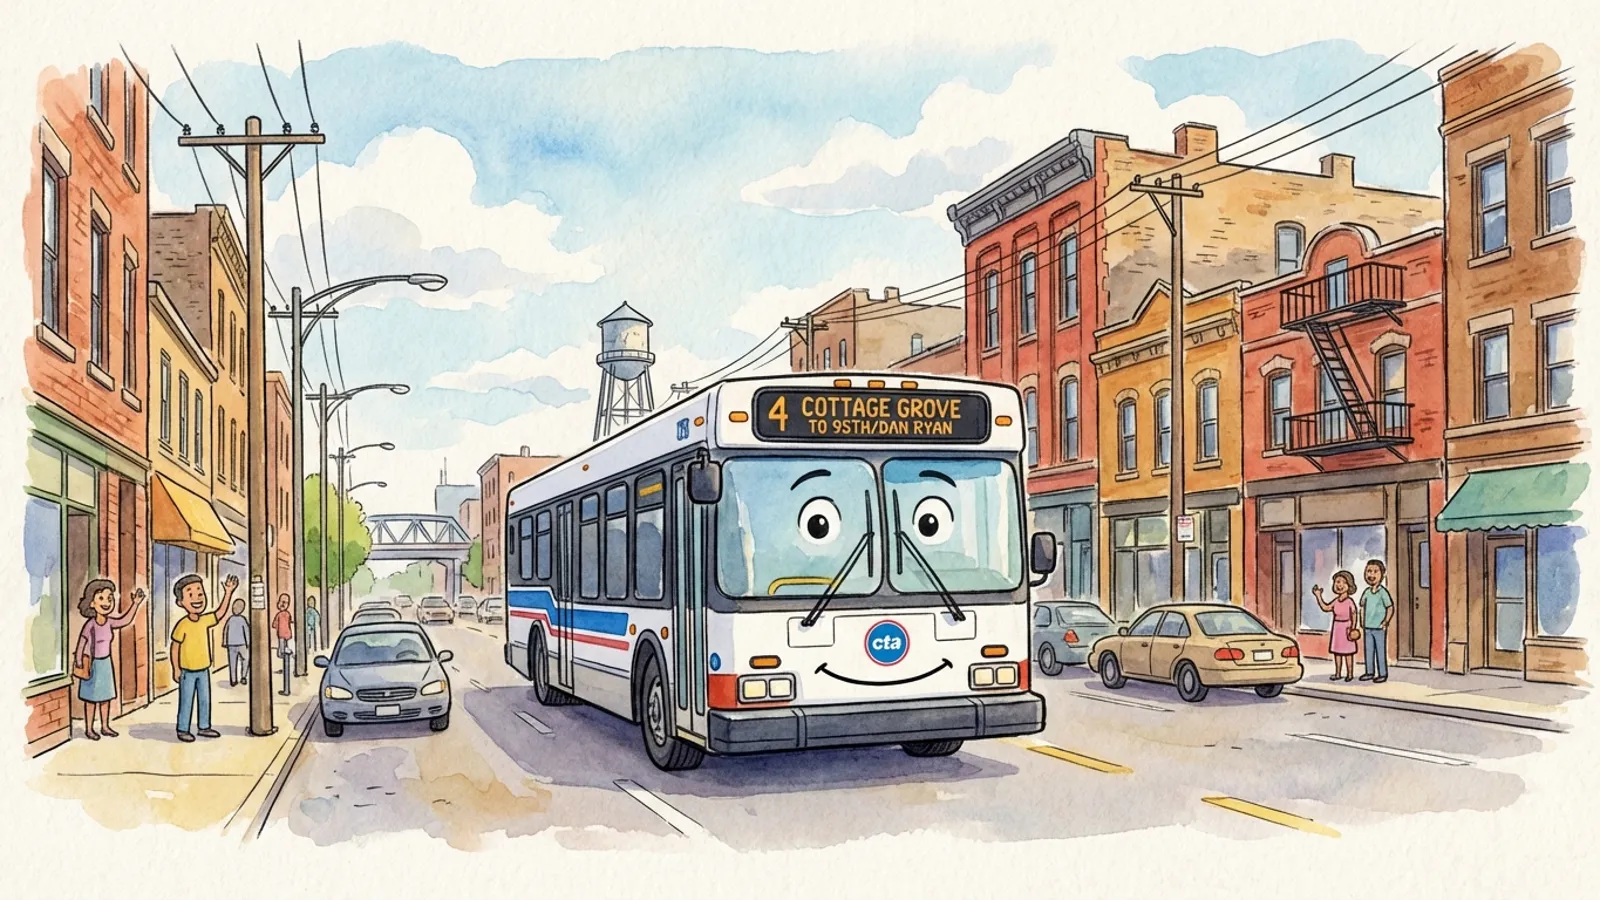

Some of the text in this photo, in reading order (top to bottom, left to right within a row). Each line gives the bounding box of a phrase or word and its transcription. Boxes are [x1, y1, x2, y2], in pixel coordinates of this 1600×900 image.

[768, 395, 788, 432] 4
[801, 396, 961, 419] COTTAGE GROVE
[808, 419, 827, 435] TO
[913, 421, 953, 435] RYAN
[872, 634, 902, 650] cta
